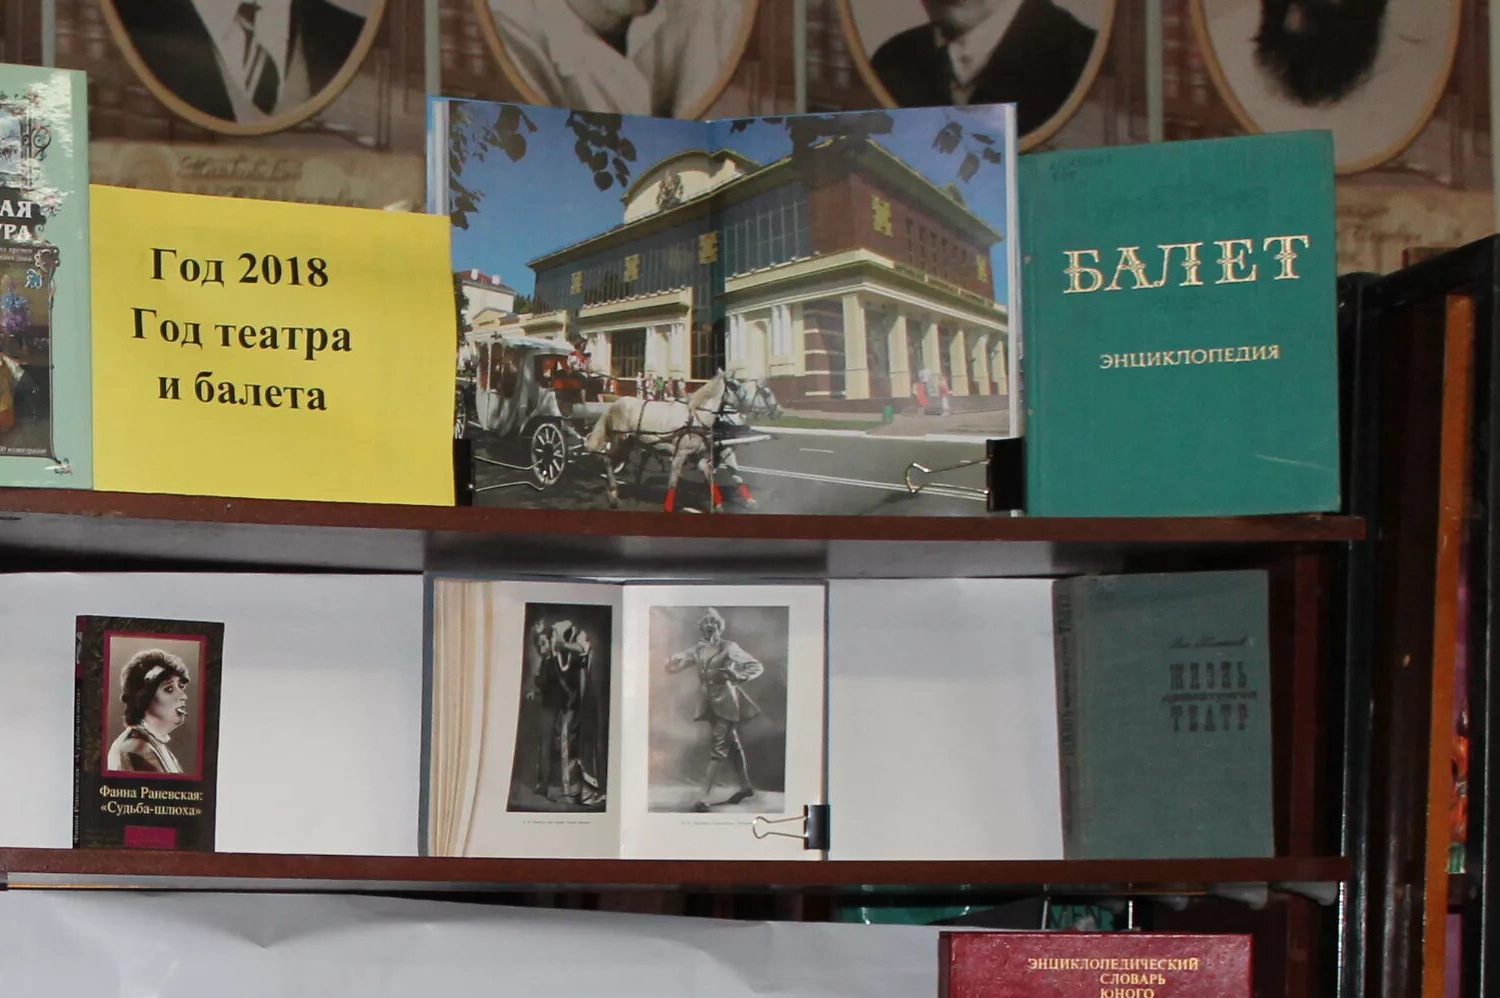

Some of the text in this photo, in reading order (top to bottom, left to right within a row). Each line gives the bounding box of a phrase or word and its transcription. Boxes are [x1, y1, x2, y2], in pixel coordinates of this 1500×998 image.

[150, 248, 329, 287] Год 2018
[1062, 234, 1310, 294] БАЛЕТ
[131, 307, 352, 361] Год театра
[1099, 344, 1281, 369] ЭНЦИКЛОПЕДИЯ
[157, 371, 327, 411] и балета
[99, 785, 138, 799] Фаина
[100, 800, 202, 817] «Судьба-шлюха»
[1027, 957, 1199, 971] ЭНЦИКЛОПЕДИЧЕСКИЙ
[1100, 973, 1166, 986] СЛОВАРЬ
